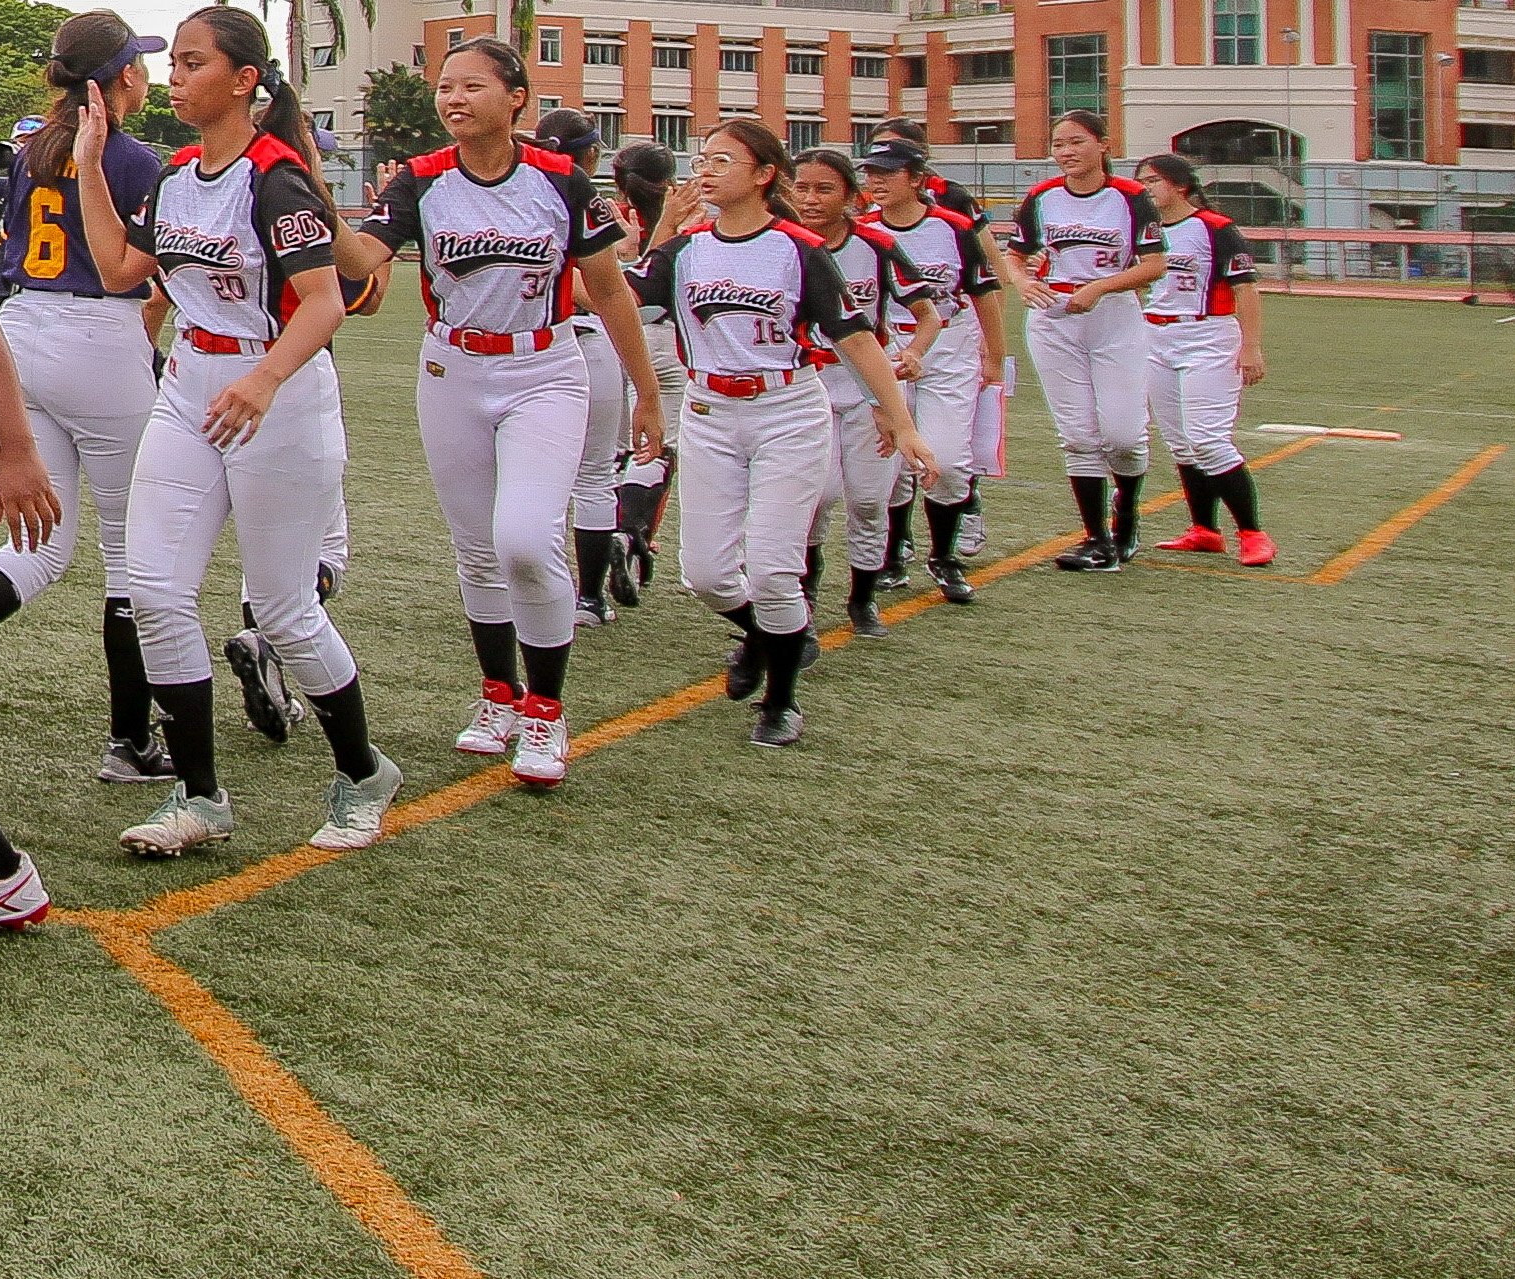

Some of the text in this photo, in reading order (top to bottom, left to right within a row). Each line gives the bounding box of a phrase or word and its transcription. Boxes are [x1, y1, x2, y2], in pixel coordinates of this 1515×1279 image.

[22, 186, 66, 280] 6
[277, 210, 320, 246] 20
[433, 229, 557, 265] National
[685, 277, 785, 318] National
